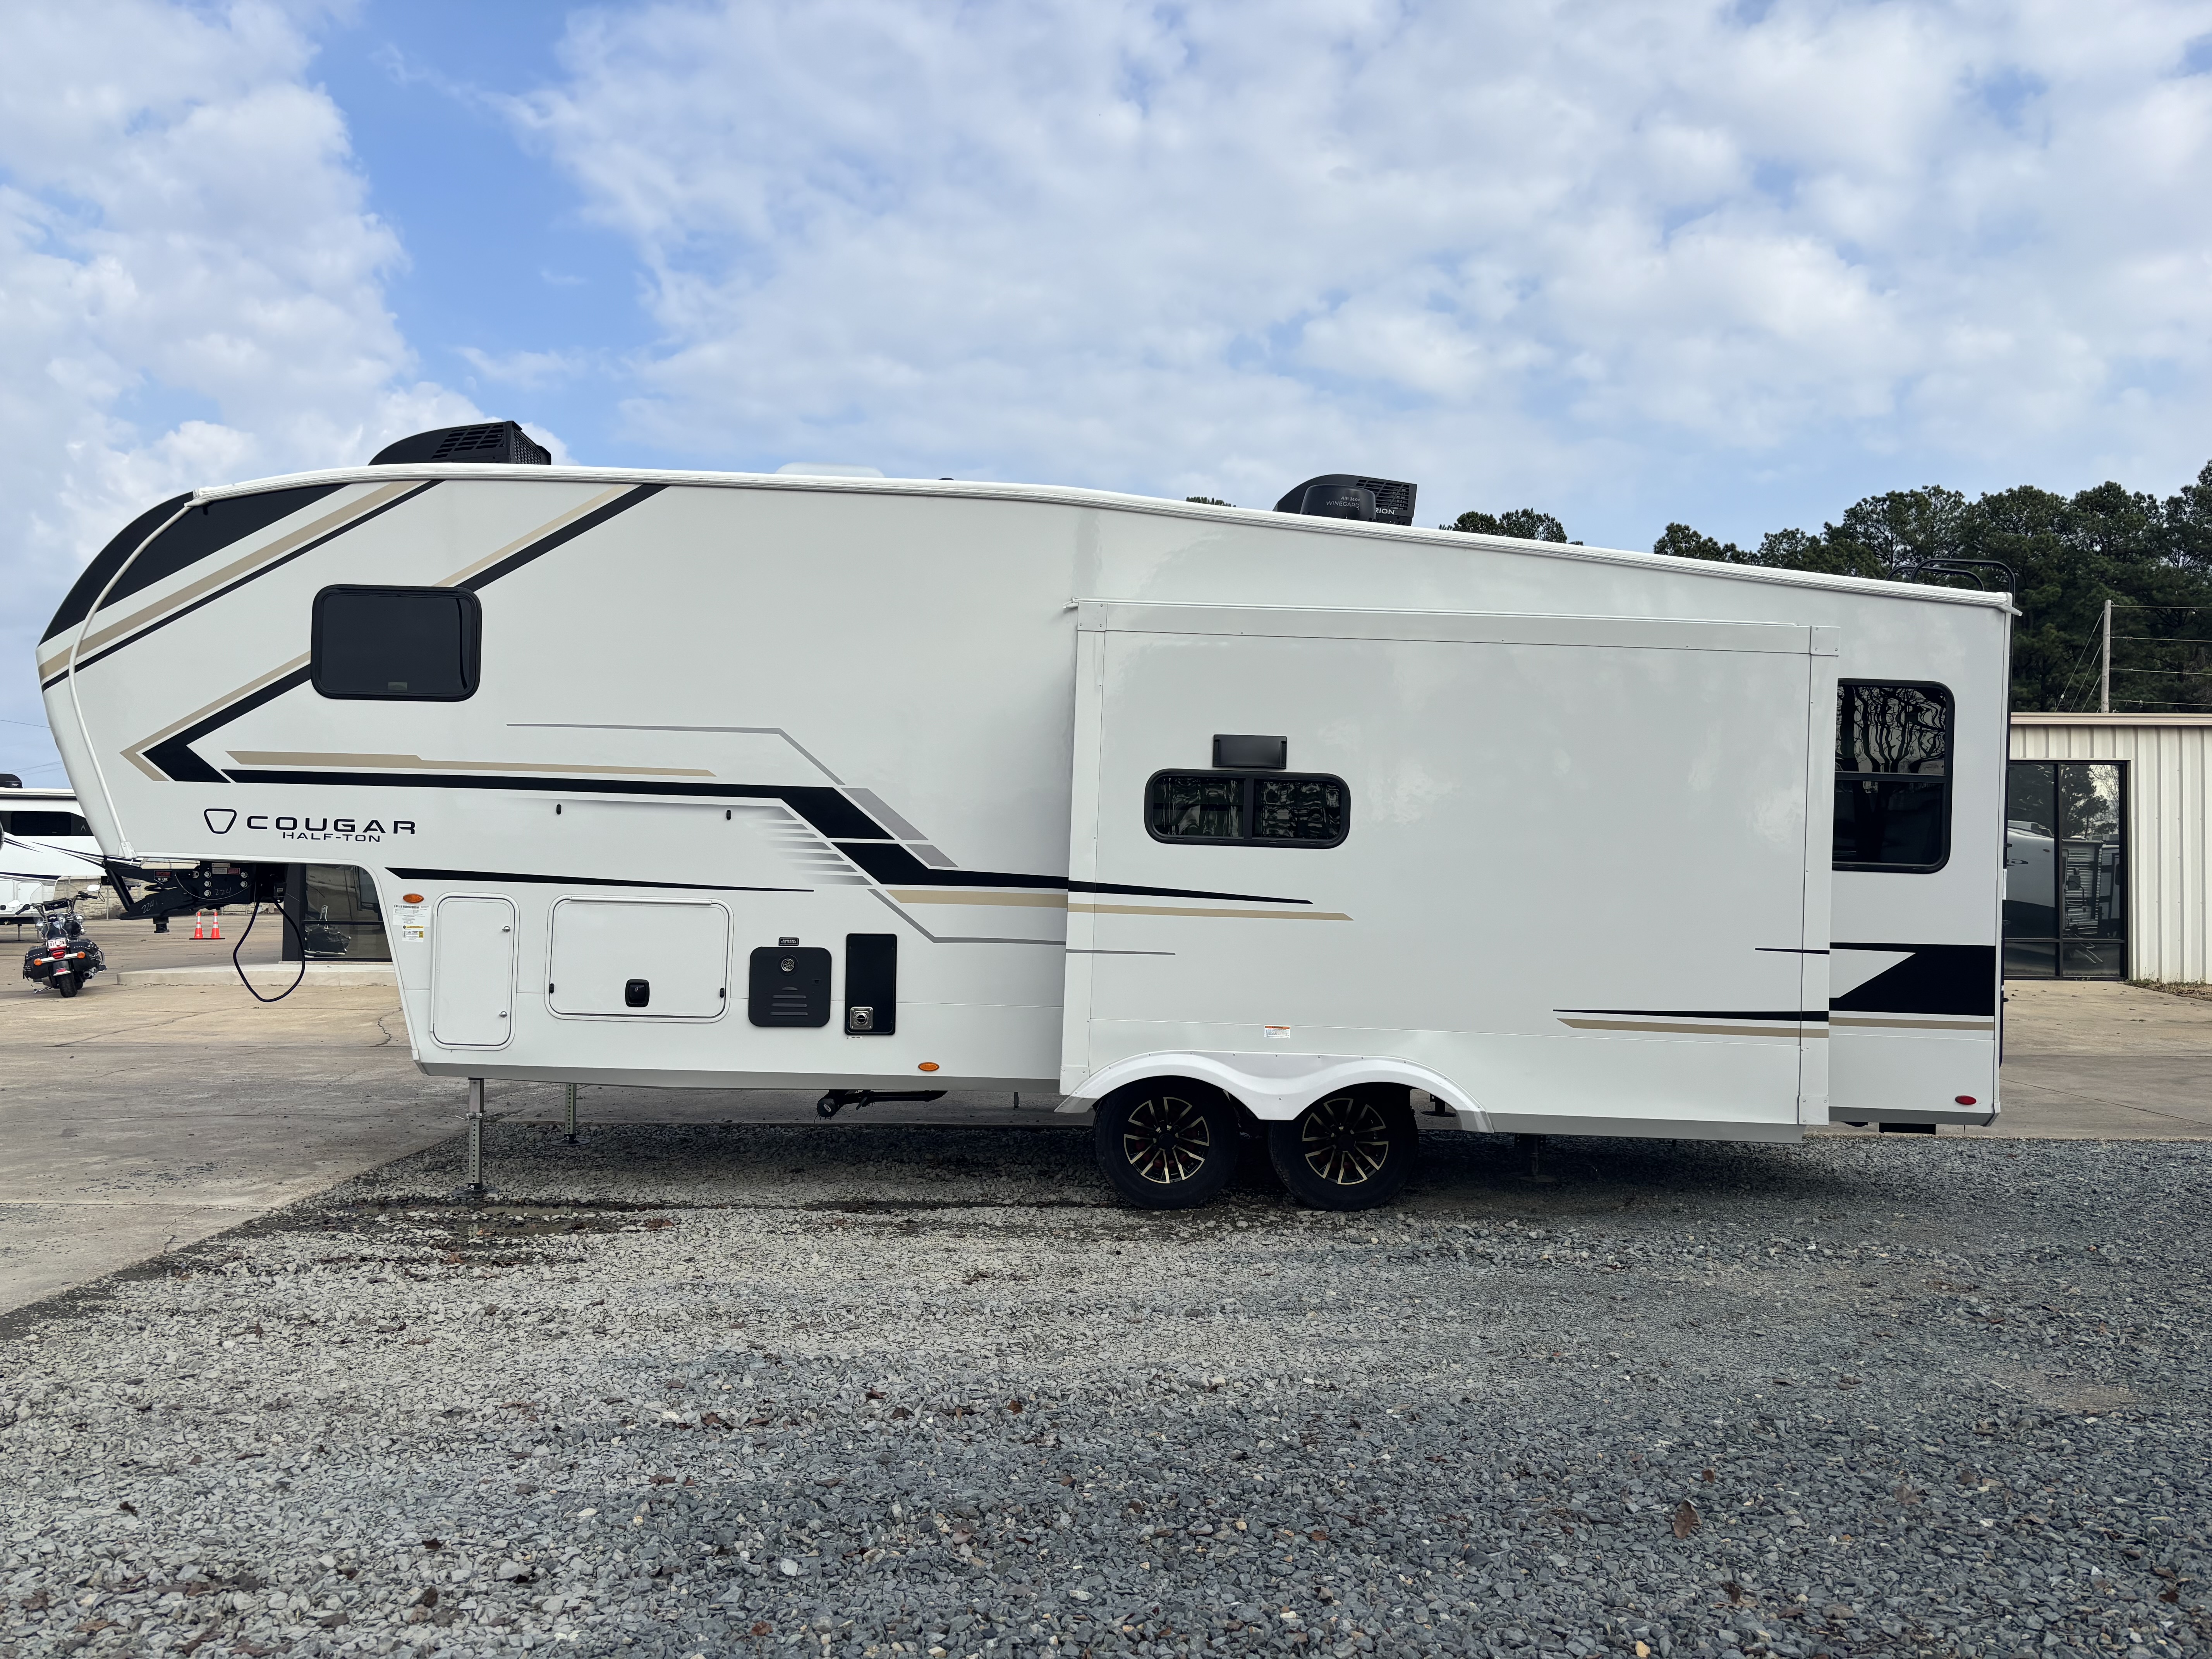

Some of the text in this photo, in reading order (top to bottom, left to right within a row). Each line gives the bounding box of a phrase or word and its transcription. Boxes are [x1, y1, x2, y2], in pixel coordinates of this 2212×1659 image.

[247, 816, 416, 835] COUGAR
[283, 831, 381, 843] HALF-TON
[215, 887, 232, 896] 224
[141, 899, 154, 914] 224
